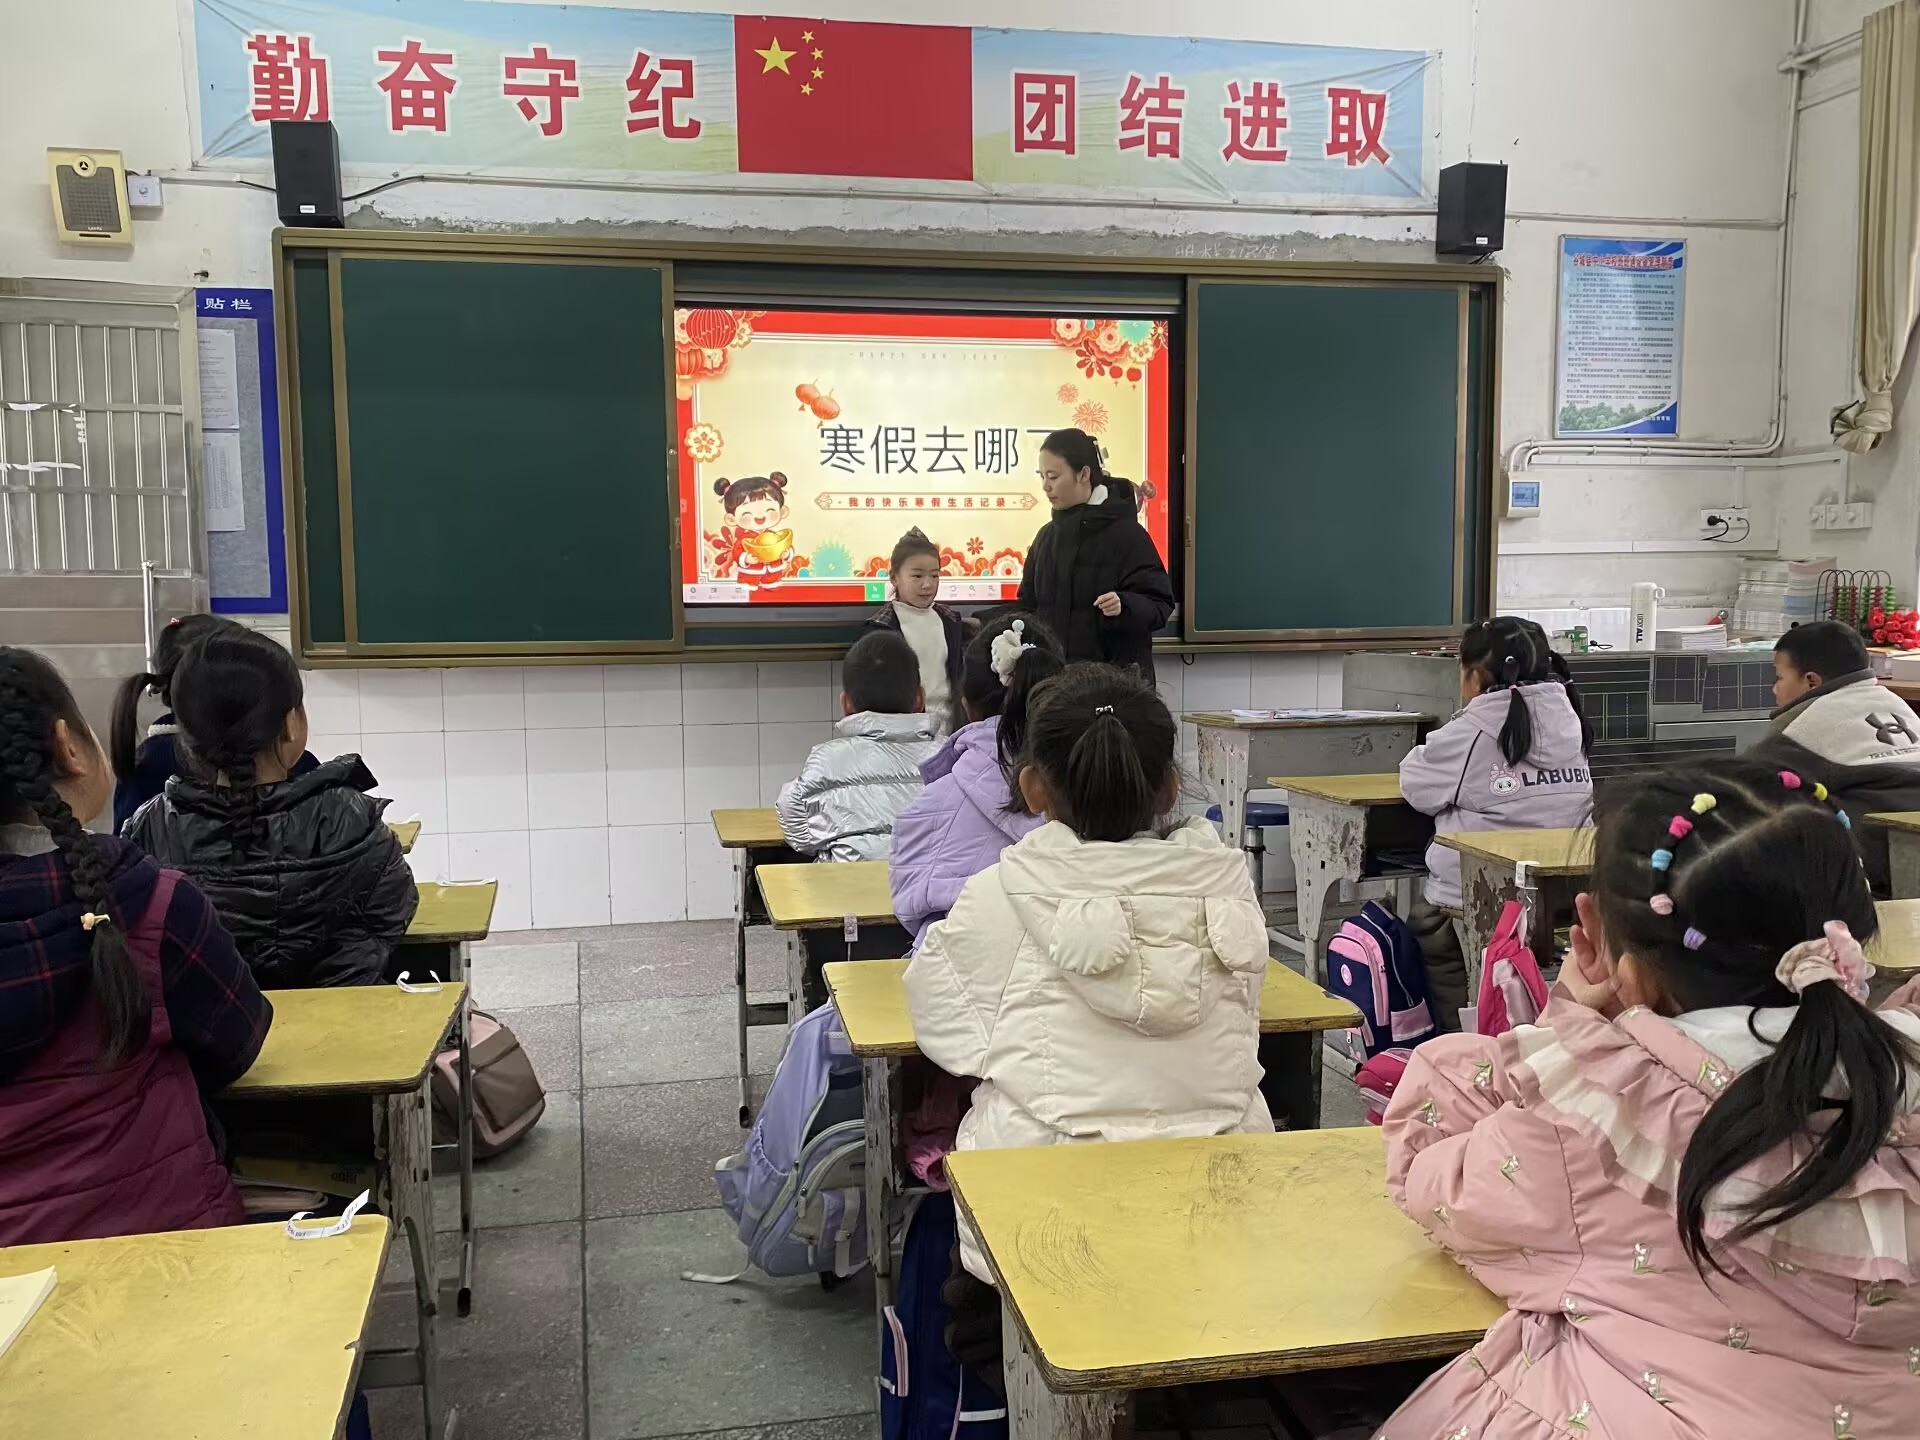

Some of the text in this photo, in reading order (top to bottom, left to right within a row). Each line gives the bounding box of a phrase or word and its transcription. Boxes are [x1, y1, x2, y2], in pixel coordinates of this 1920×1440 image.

[246, 34, 701, 139] 勤奋守纪
[1013, 71, 1391, 167] 团结进取
[197, 297, 253, 311] 贴栏
[848, 497, 1006, 508] 我的快乐寒假生活记录
[1521, 768, 1590, 787] LABUBU
